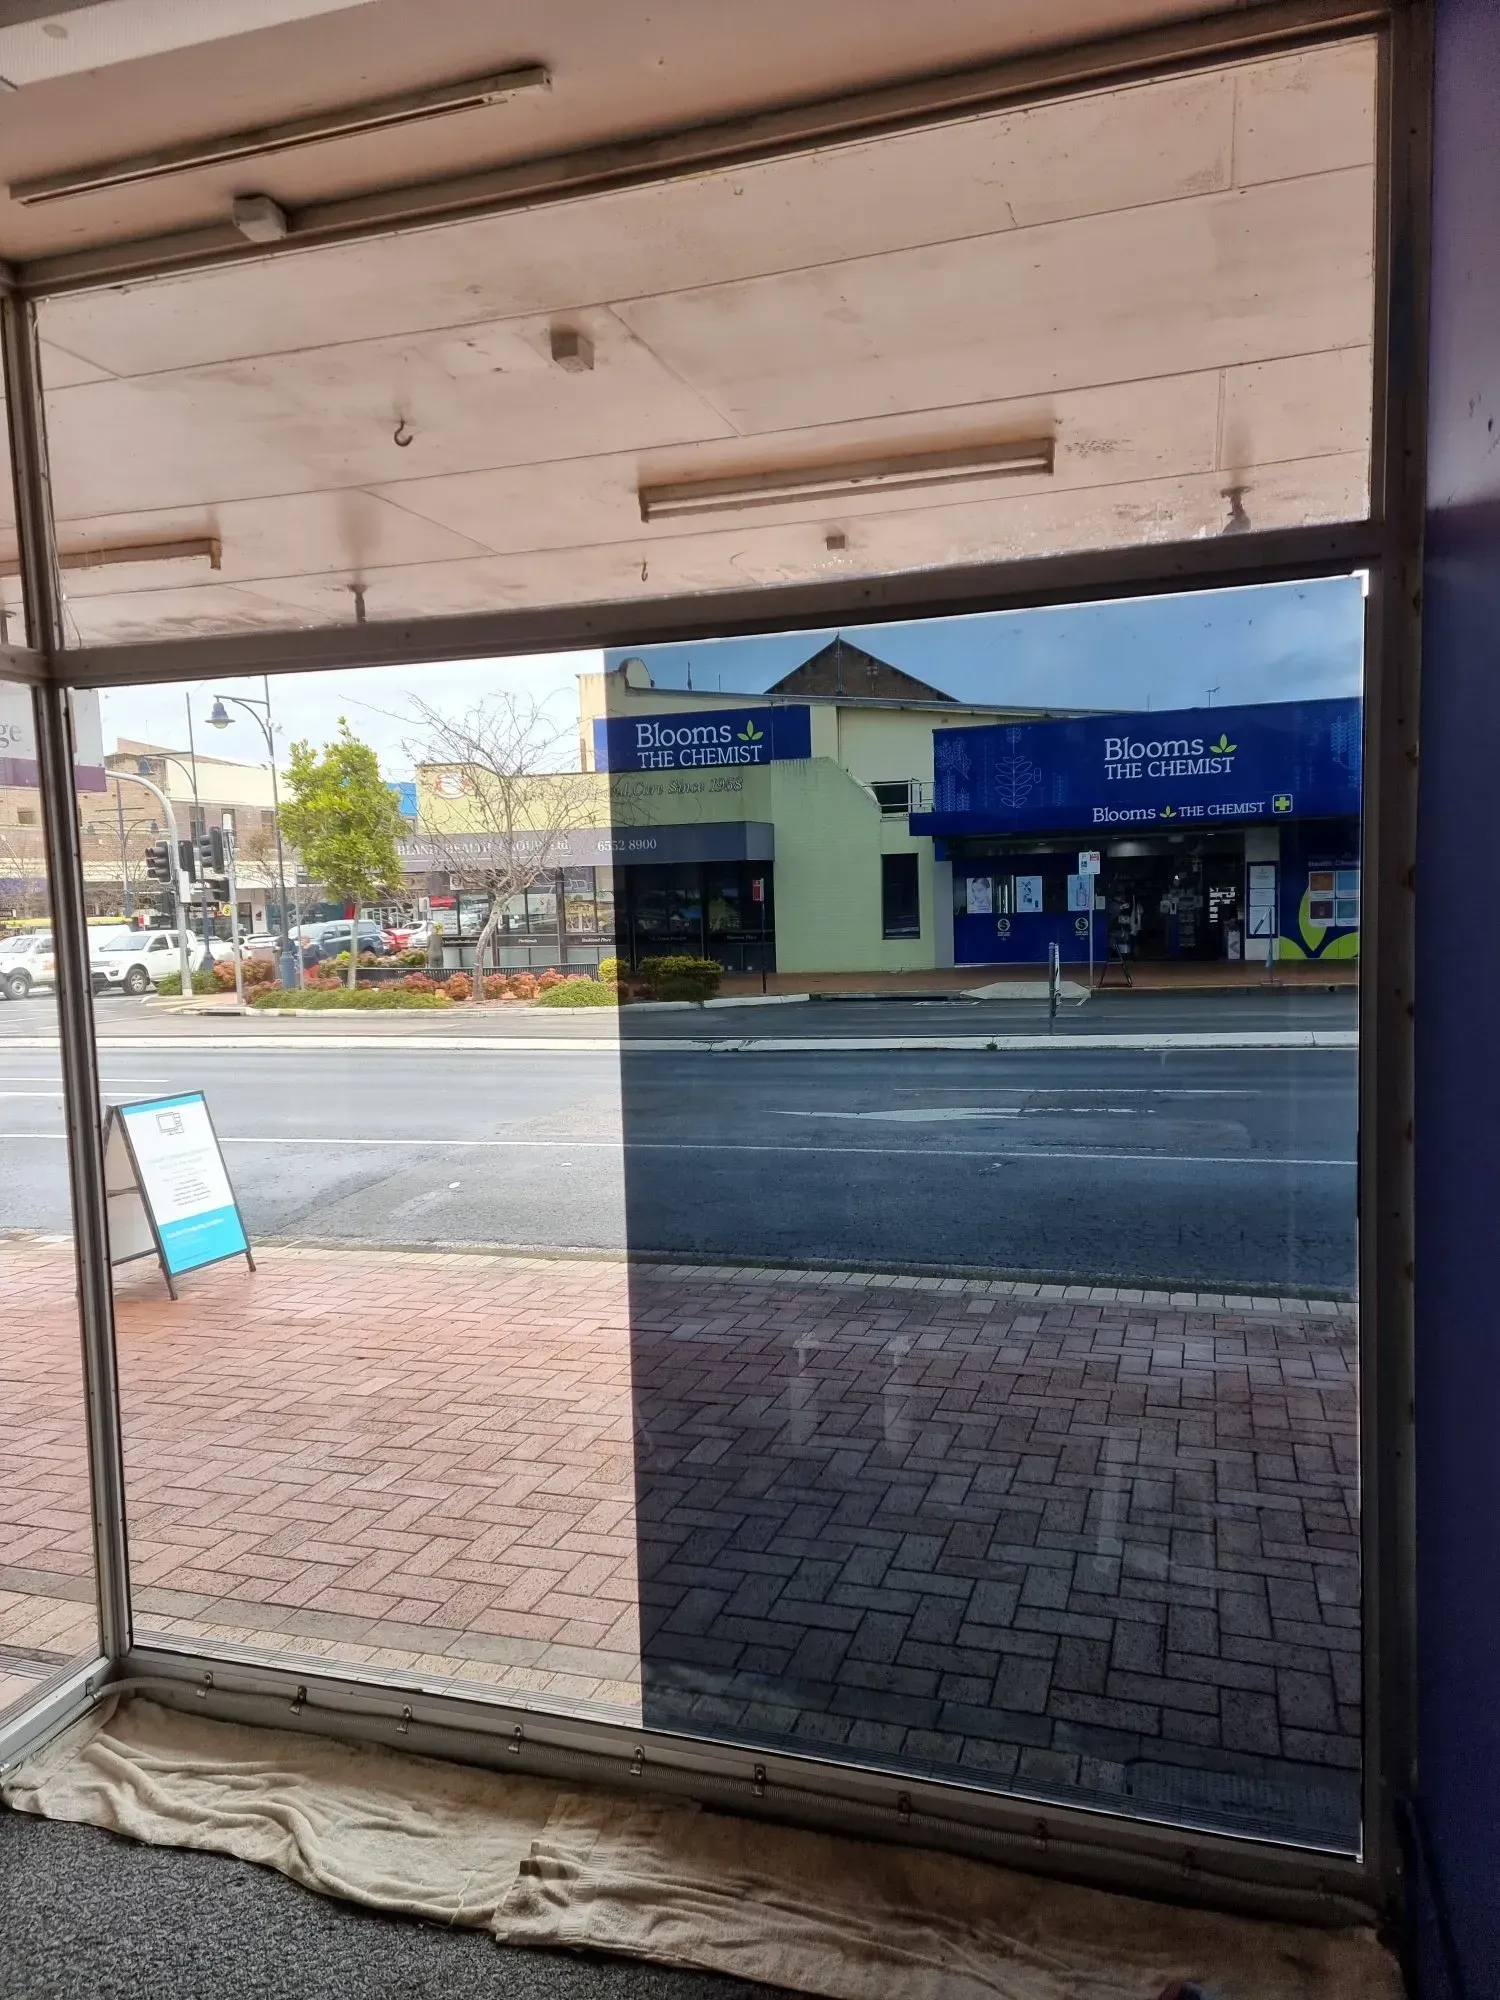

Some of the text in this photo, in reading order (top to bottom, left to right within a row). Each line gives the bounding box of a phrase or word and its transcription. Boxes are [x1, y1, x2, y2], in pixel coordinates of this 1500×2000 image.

[635, 721, 732, 749] Blooms
[637, 744, 763, 769] THE CHEMIST
[1104, 736, 1204, 762] Blooms
[1104, 756, 1235, 780] THE CHEMIST
[632, 781, 664, 797] Care
[668, 778, 705, 795] Since
[1092, 801, 1266, 823] Blooms THE CHEMIST
[597, 838, 657, 852] 6552 8900
